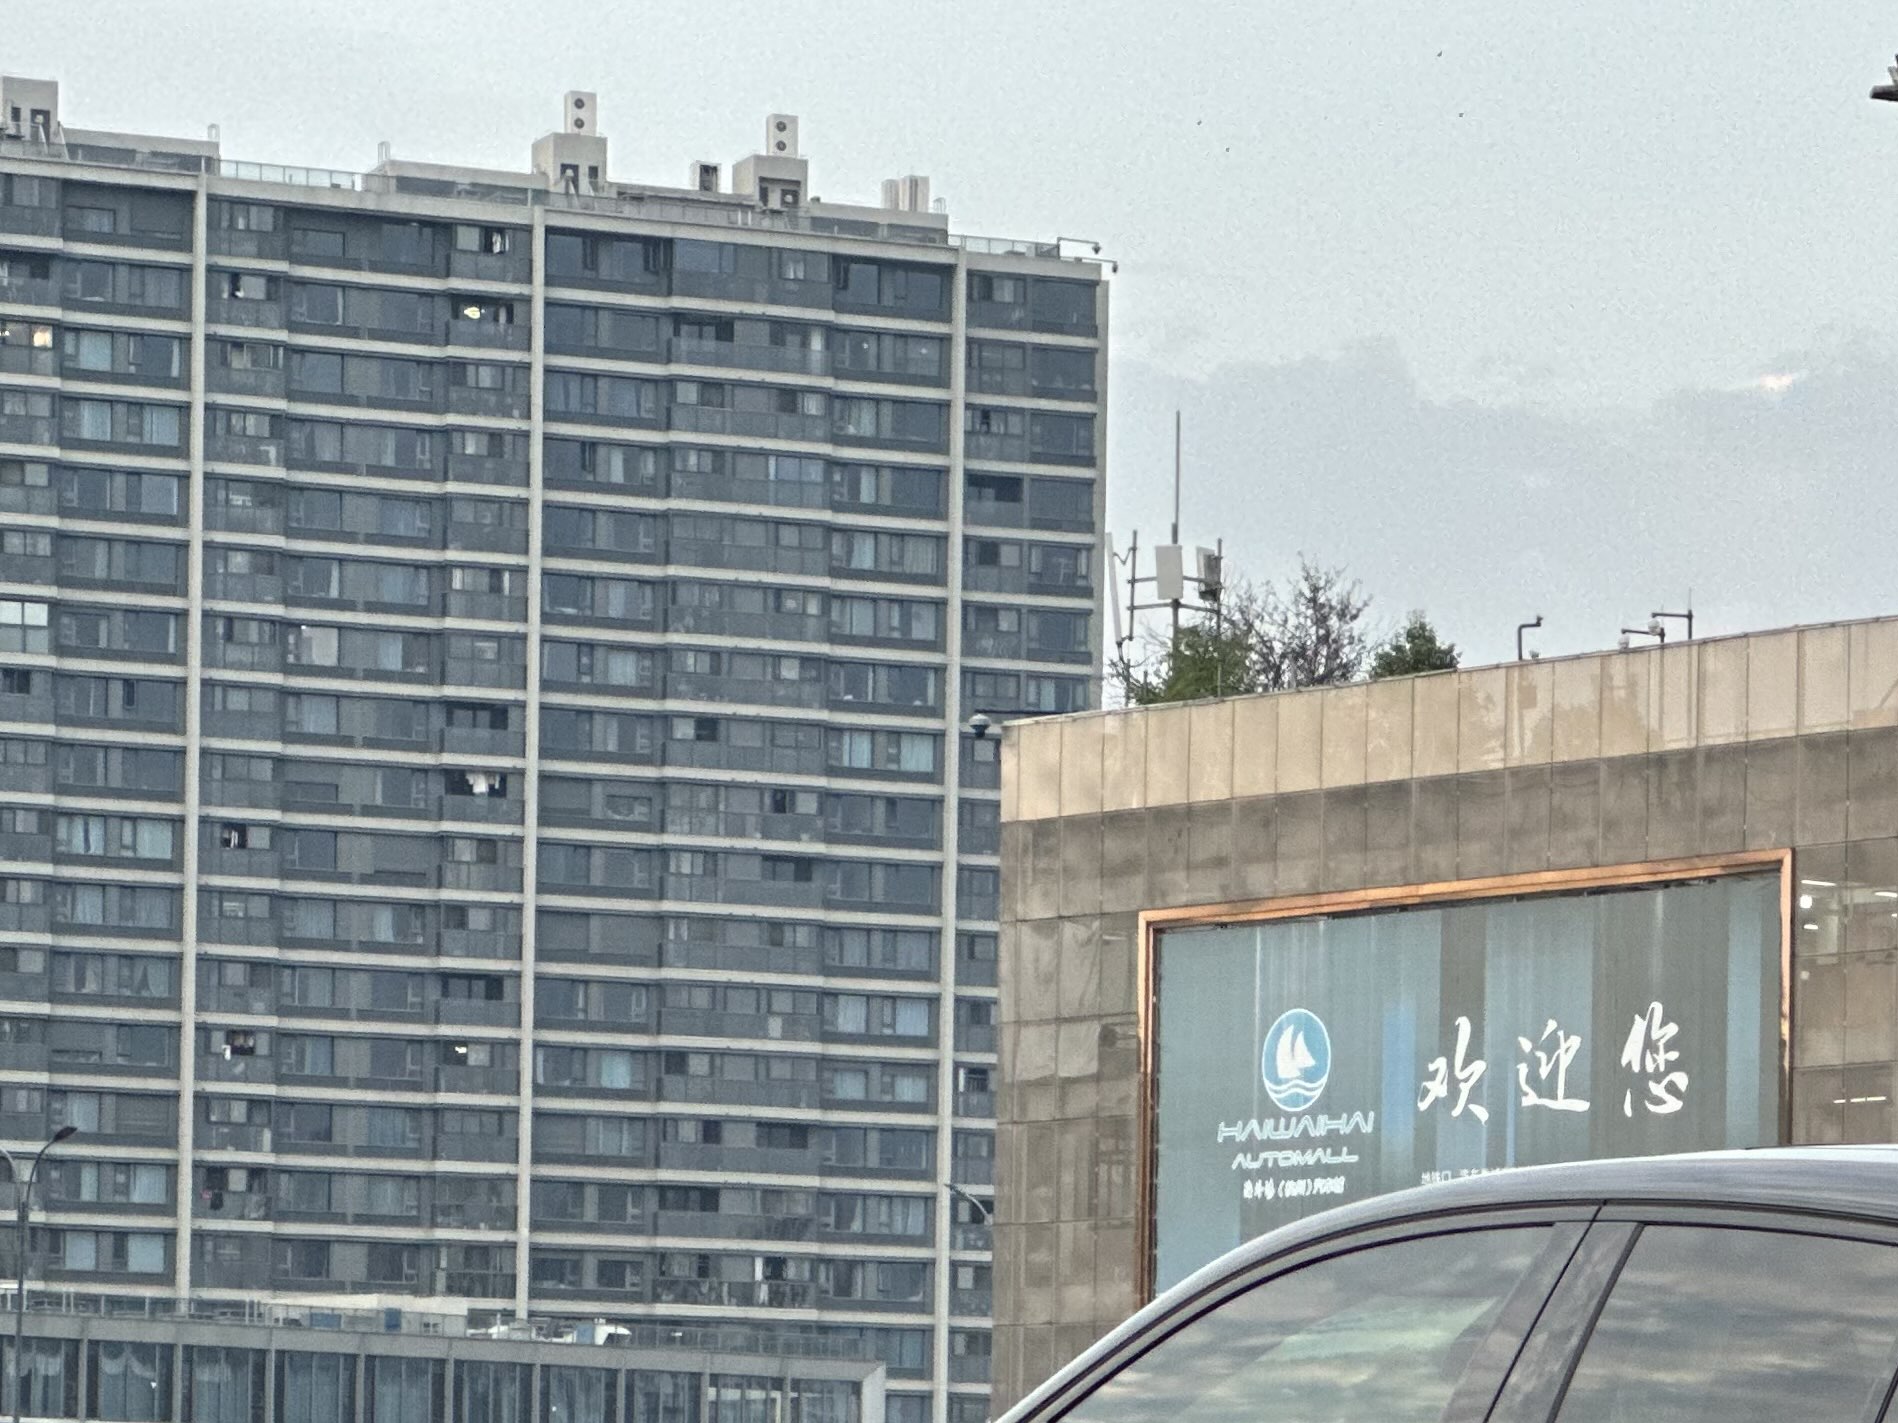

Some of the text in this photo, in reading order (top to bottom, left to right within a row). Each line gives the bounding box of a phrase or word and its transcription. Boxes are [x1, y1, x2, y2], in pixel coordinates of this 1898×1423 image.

[1417, 1001, 1689, 1125] 欢迎您
[1217, 1111, 1375, 1143] HAIWAIHAI
[1231, 1147, 1359, 1170] AUTOMALL
